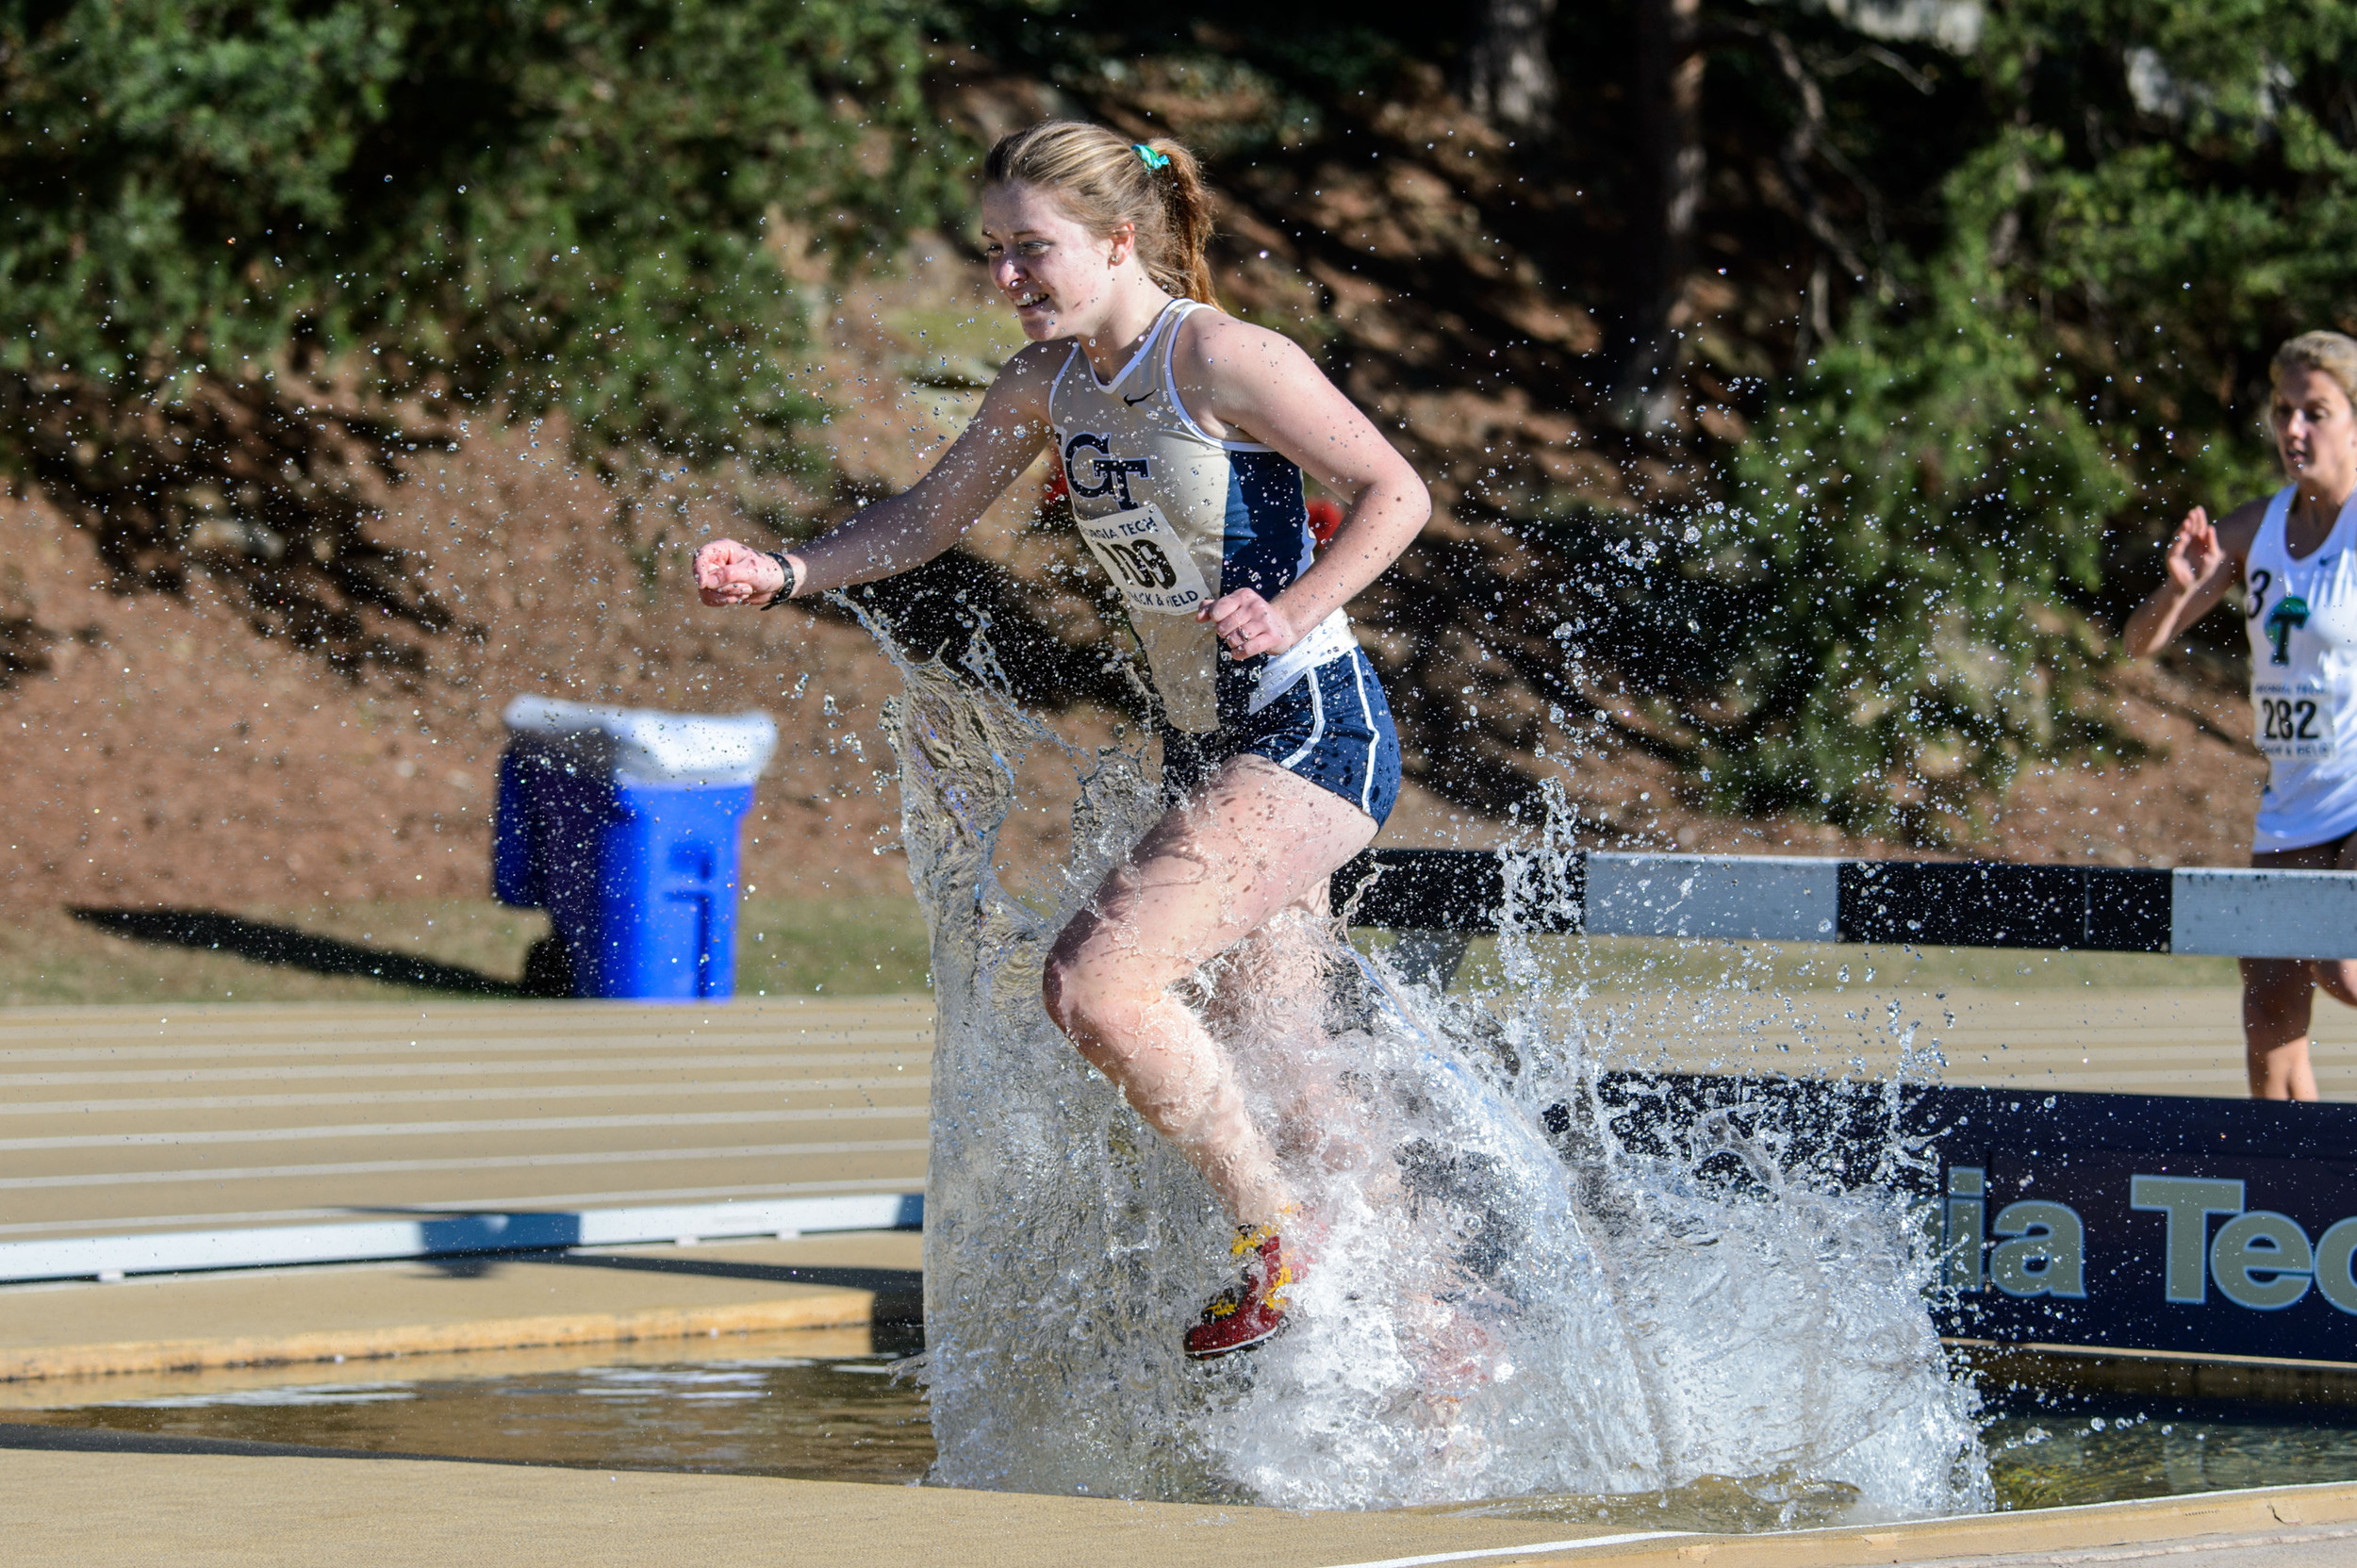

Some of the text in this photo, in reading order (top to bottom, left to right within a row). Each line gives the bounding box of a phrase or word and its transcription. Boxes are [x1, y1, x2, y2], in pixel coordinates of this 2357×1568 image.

[1064, 431, 1150, 512] GT
[1079, 516, 1159, 540] RGIA TECH
[1096, 538, 1177, 590] 109
[2247, 569, 2272, 619] 3
[2262, 699, 2319, 740] 282
[1906, 1166, 2087, 1299] ia
